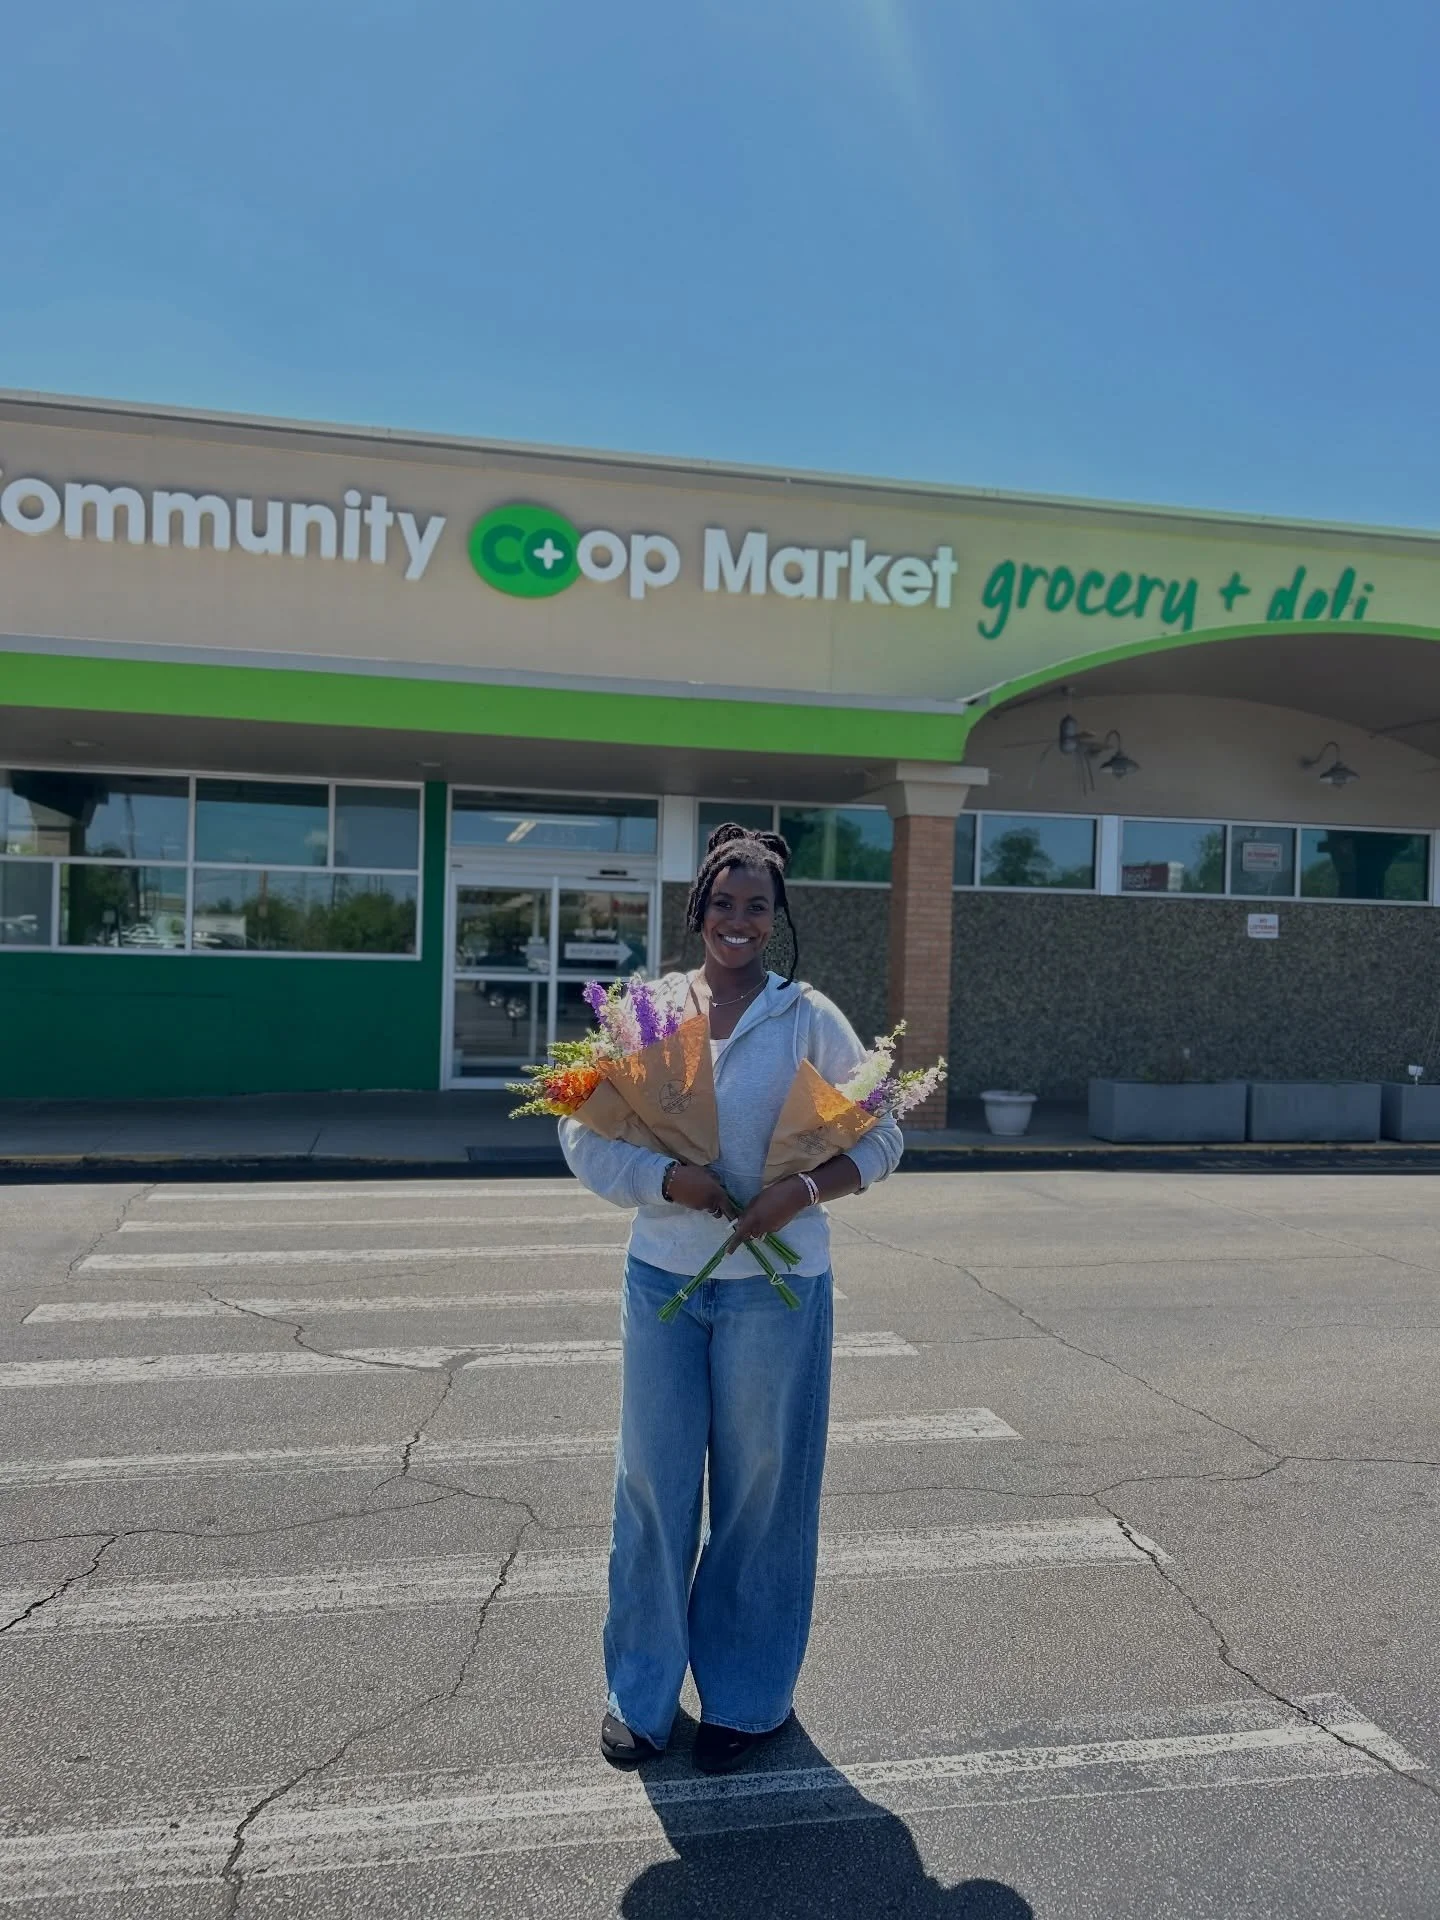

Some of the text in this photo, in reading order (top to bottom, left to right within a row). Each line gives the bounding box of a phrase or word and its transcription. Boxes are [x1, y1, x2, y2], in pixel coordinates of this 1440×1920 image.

[0, 470, 446, 580] ommunity
[703, 529, 958, 608] Market
[978, 559, 1198, 639] grocery
